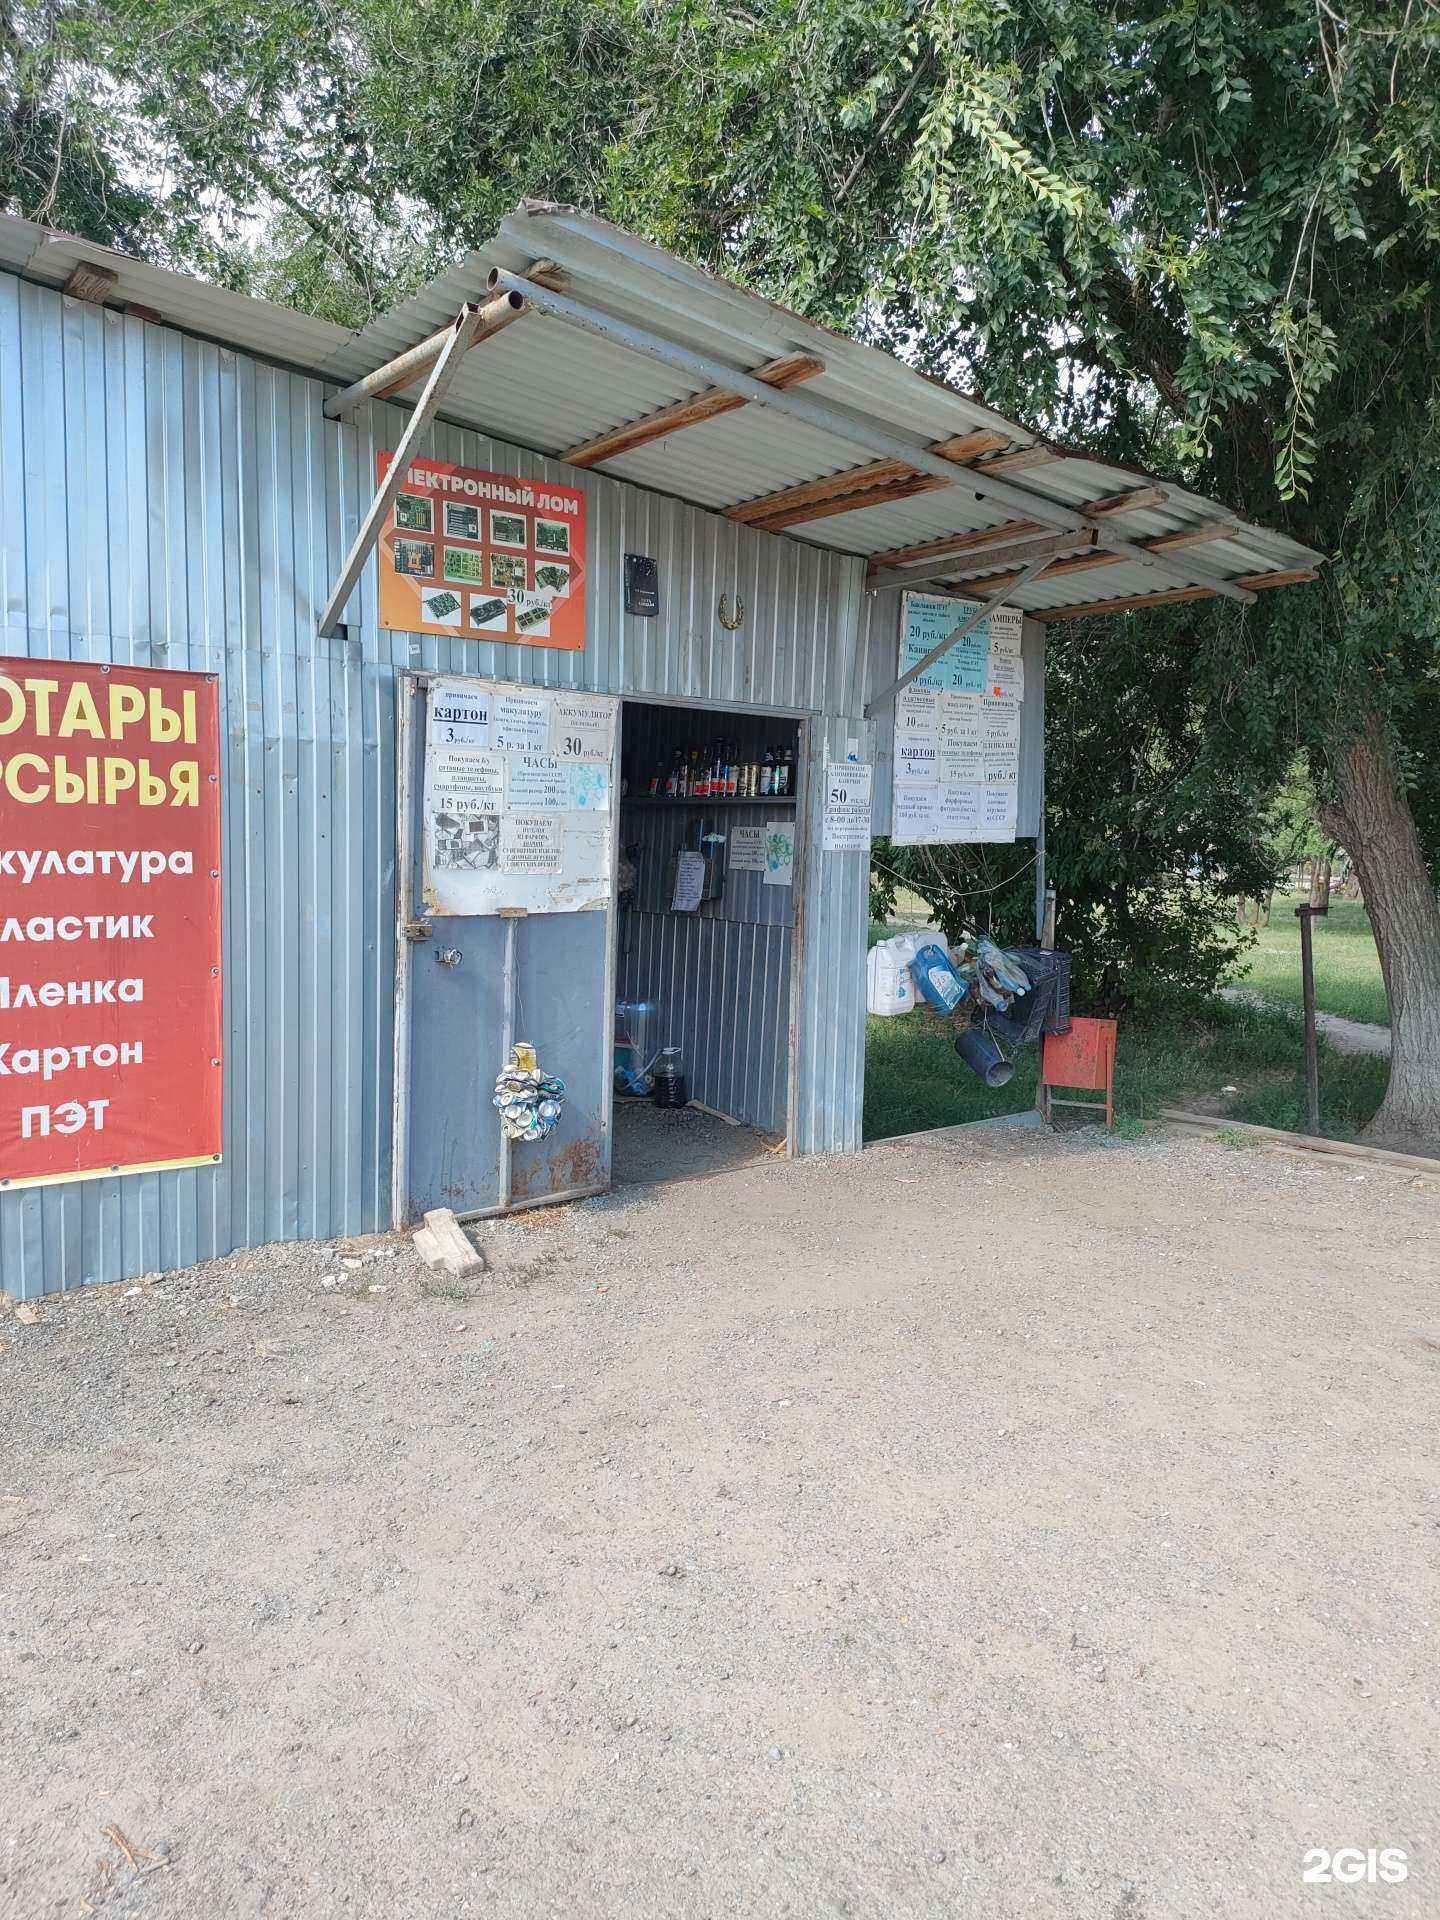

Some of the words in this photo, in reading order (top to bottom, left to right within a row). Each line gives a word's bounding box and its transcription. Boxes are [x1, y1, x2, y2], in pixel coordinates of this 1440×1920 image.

[387, 463, 534, 507] ЕКТРОННЫЙ
[537, 493, 578, 515] ЛОМ
[509, 588, 524, 604] 30
[909, 625, 921, 638] 20
[993, 641, 999, 653] 5
[952, 673, 963, 685] 20
[434, 706, 487, 722] картон
[500, 706, 543, 720] макулатуру
[446, 727, 454, 743] 3
[497, 735, 504, 748] 5
[563, 736, 582, 756] 30
[448, 754, 480, 764] Покупаем
[901, 747, 935, 759] картон
[523, 756, 557, 769] ЧАСЫ
[906, 762, 911, 775] 3
[0, 752, 199, 807] СЫРЬЯ
[544, 785, 556, 794] 200
[830, 788, 847, 804] 50
[441, 797, 453, 809] 15
[0, 850, 193, 884] кулатура
[22, 1099, 110, 1139] ПЭТ
